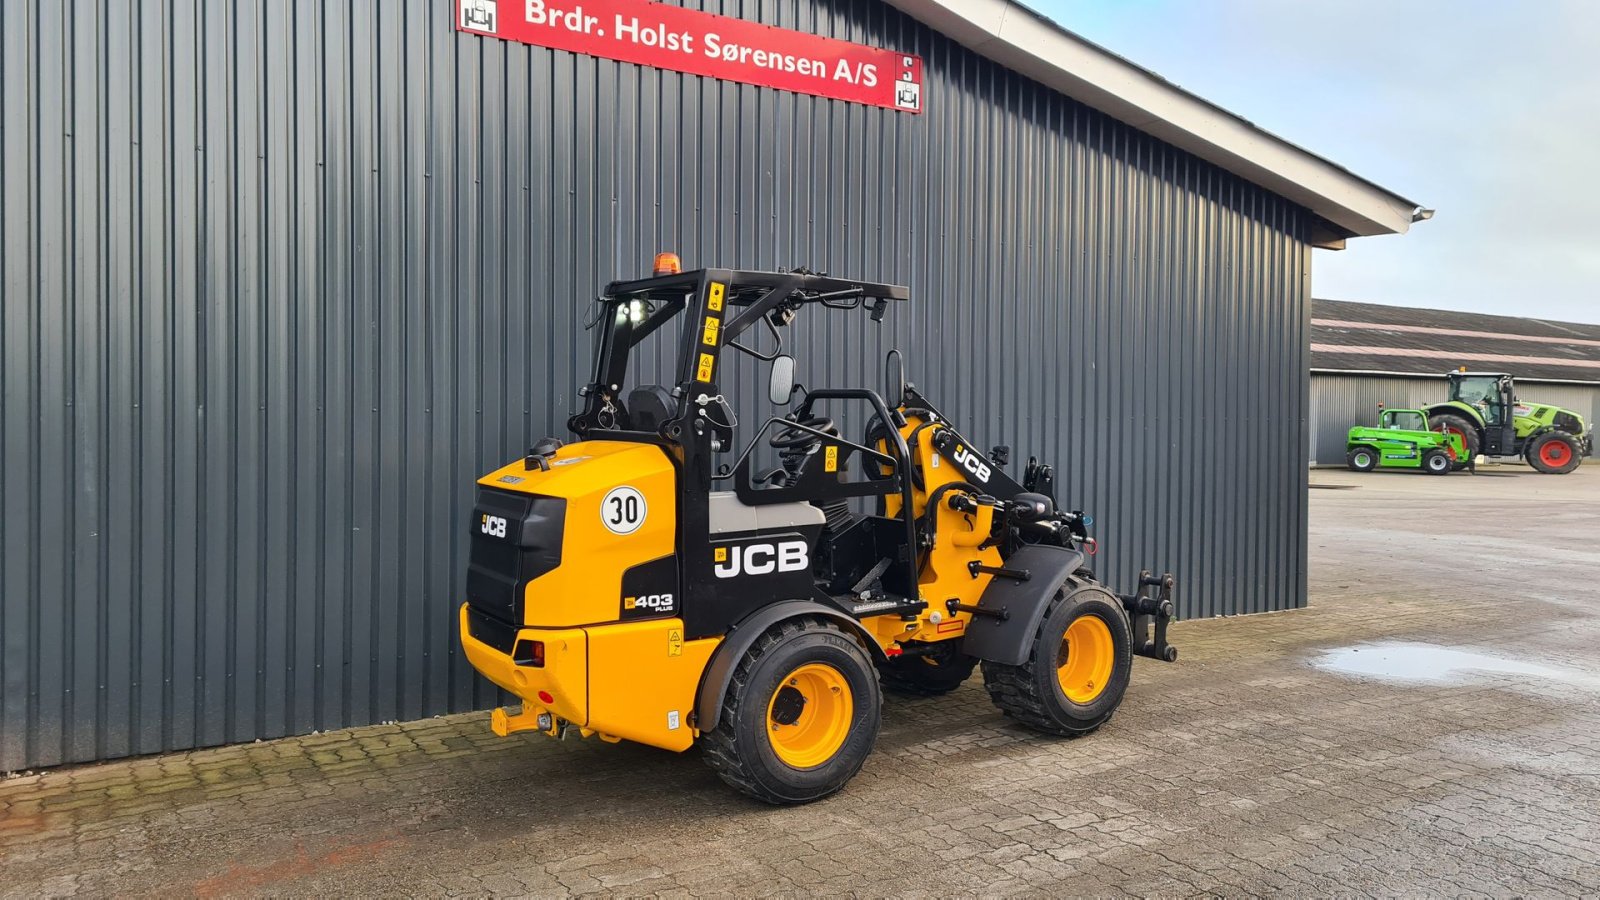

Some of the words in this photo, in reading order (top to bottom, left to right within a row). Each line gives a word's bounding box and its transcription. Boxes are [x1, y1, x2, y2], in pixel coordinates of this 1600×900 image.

[525, 0, 604, 36] Brdr.
[615, 13, 694, 53] Holst
[703, 32, 826, 78] Sørensen
[833, 58, 878, 87] A/S
[953, 447, 991, 483] JCB
[481, 514, 507, 538] JCB
[610, 495, 638, 525] 30
[714, 541, 809, 578] JCB
[635, 594, 673, 608] 403
